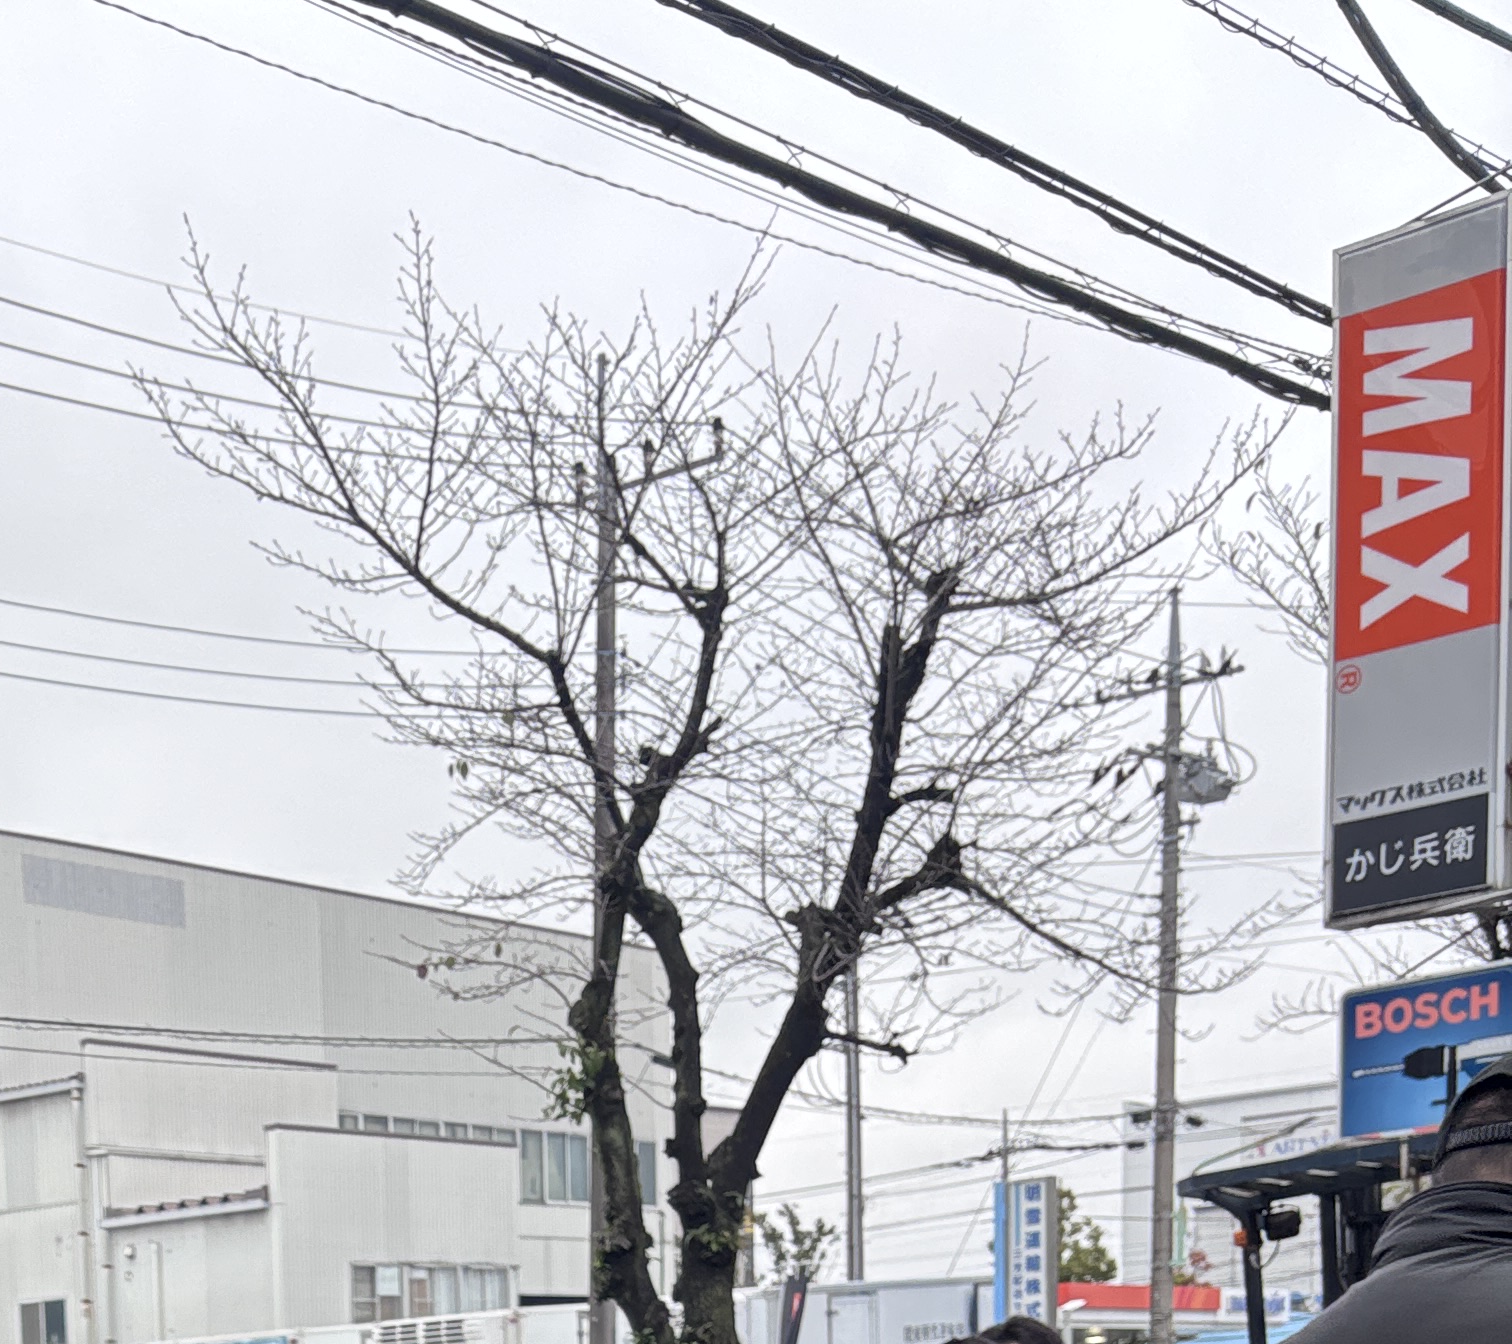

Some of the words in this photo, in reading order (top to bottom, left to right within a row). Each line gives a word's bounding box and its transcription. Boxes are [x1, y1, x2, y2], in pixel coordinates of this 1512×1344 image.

[1359, 316, 1474, 632] MAX
[1336, 767, 1487, 813] マックス株式会社
[1344, 825, 1477, 883] かじ兵衛
[1354, 981, 1500, 1040] BOSCH
